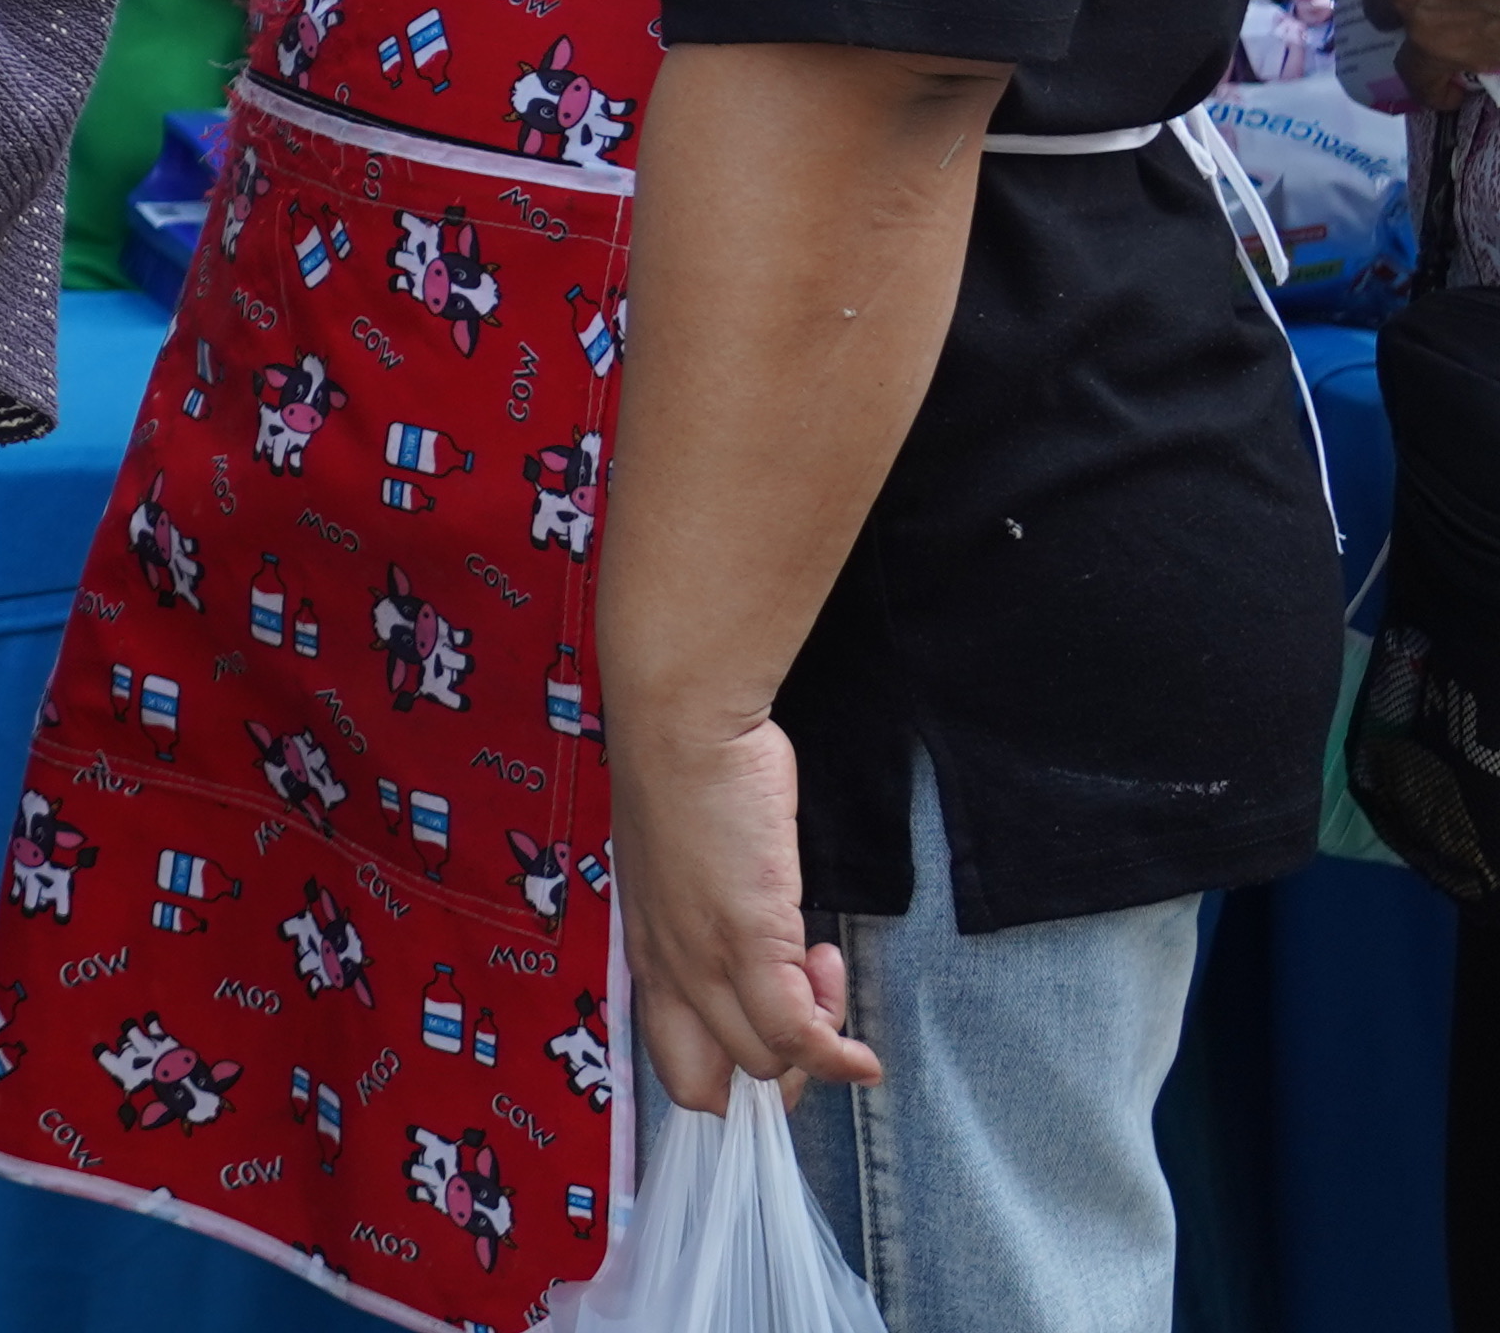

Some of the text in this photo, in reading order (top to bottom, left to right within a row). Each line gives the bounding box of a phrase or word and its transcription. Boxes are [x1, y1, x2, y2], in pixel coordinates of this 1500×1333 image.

[500, 187, 569, 242] COW
[231, 288, 278, 330] COW
[350, 316, 405, 373] COW
[507, 341, 540, 424] COW
[211, 454, 237, 517] COW
[296, 508, 361, 553] COW
[464, 552, 532, 610] COW
[316, 688, 368, 755] COW
[470, 747, 546, 793] COW
[355, 860, 411, 921] COW
[58, 946, 131, 989] COW
[487, 942, 560, 978] COW
[214, 977, 283, 1017] COW
[355, 1046, 402, 1107] COW
[38, 1108, 104, 1169] COW
[491, 1093, 556, 1149] COW
[220, 1155, 284, 1191] COW
[350, 1220, 419, 1262] COW
